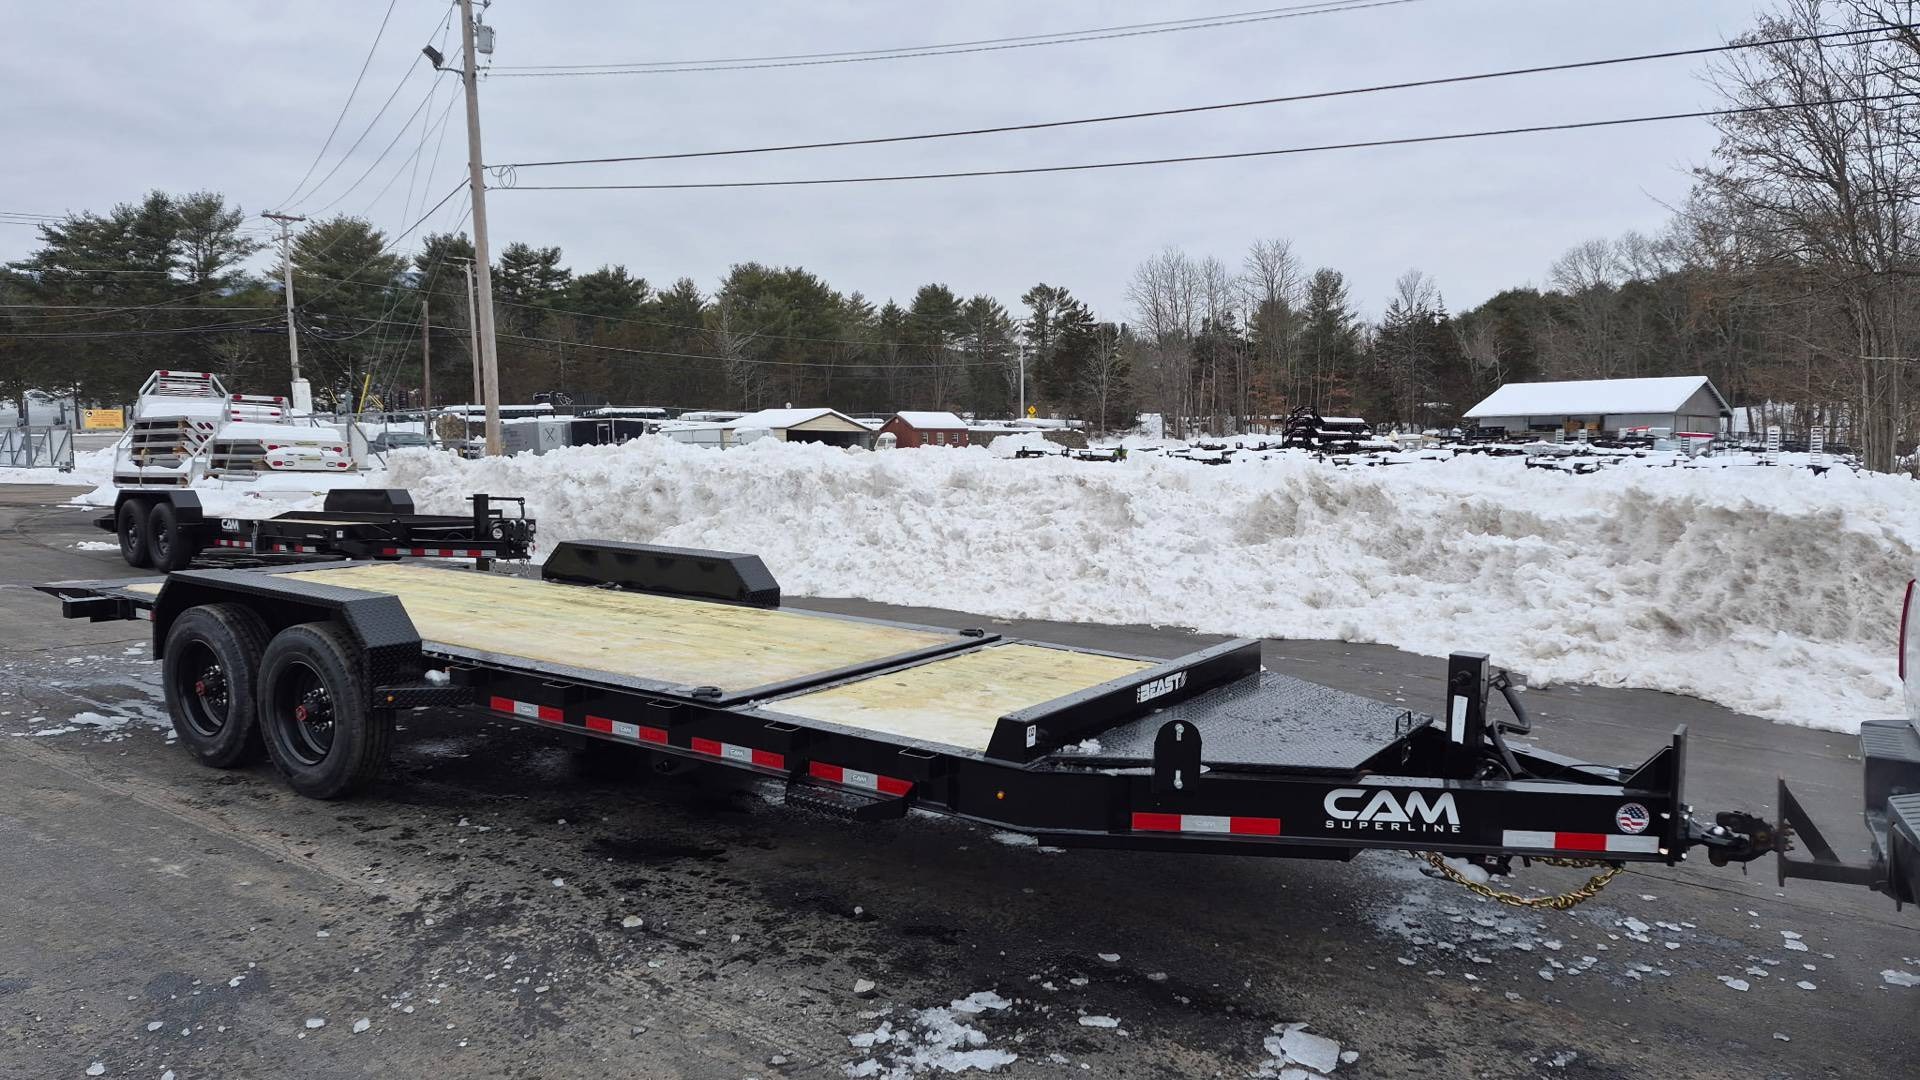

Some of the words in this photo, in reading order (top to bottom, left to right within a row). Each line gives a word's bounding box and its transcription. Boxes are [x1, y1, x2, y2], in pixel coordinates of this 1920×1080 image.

[221, 519, 239, 530] CAM
[1140, 671, 1182, 703] BEAST
[852, 774, 867, 783] CAM
[1323, 788, 1461, 825] CAM
[1325, 820, 1461, 833] SUPERLINE
